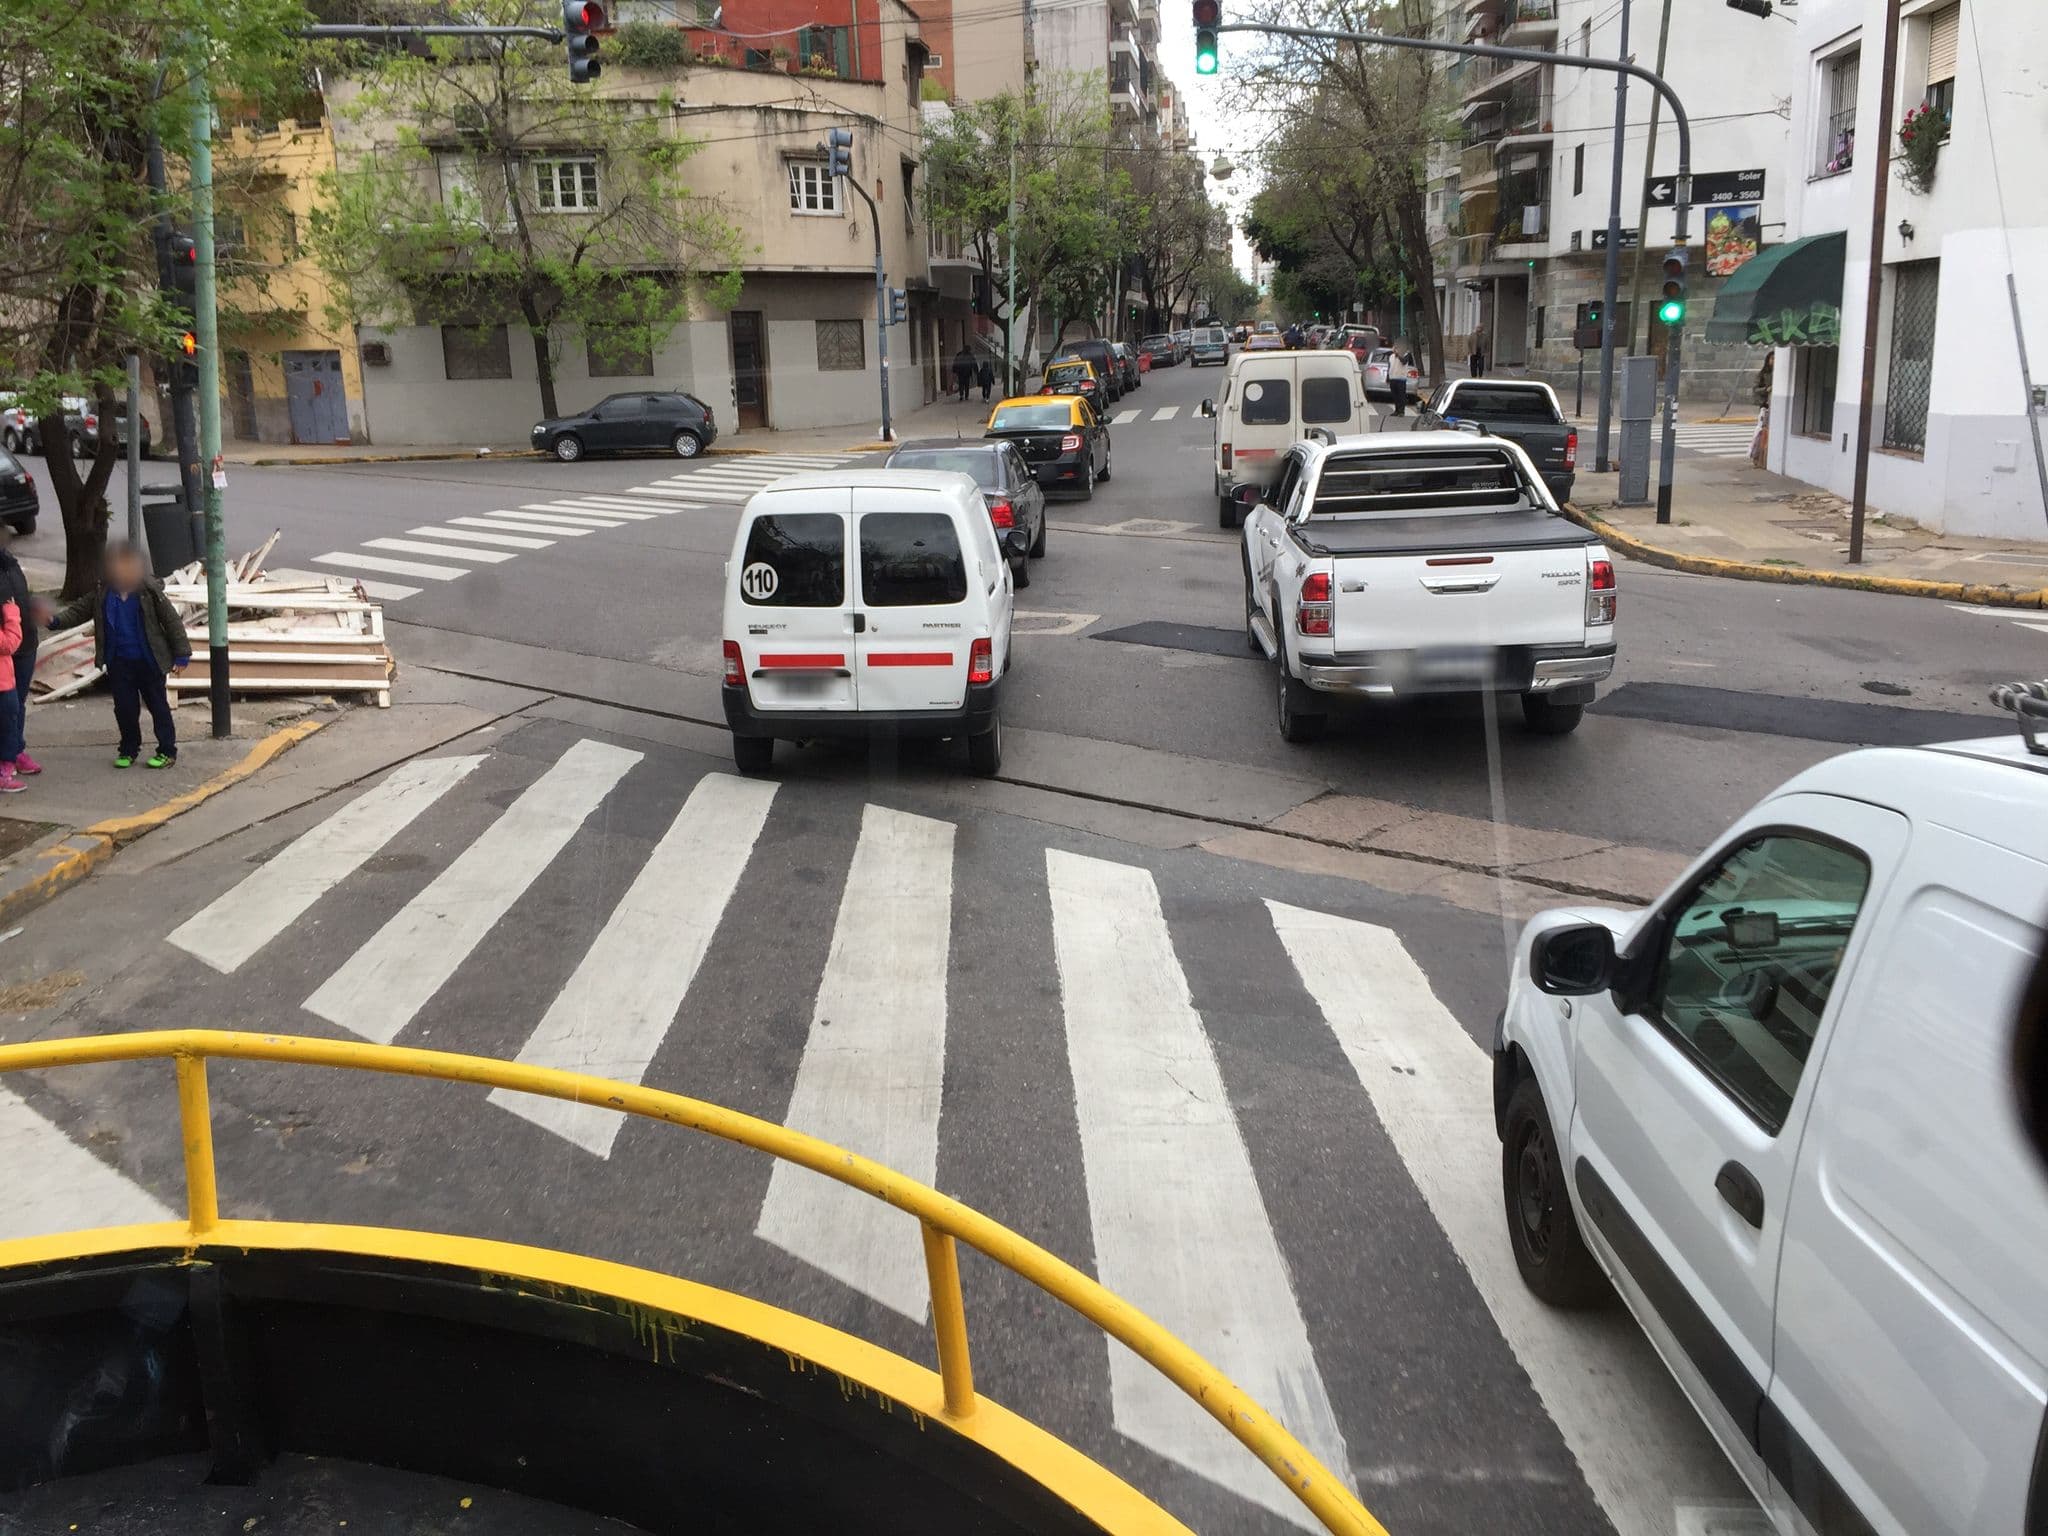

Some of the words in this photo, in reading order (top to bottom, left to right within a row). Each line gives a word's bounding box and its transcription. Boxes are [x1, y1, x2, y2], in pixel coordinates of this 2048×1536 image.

[1738, 172, 1761, 181] Soler
[1712, 192, 1731, 201] 3400
[1739, 190, 1760, 200] 3500
[746, 569, 773, 593] 110
